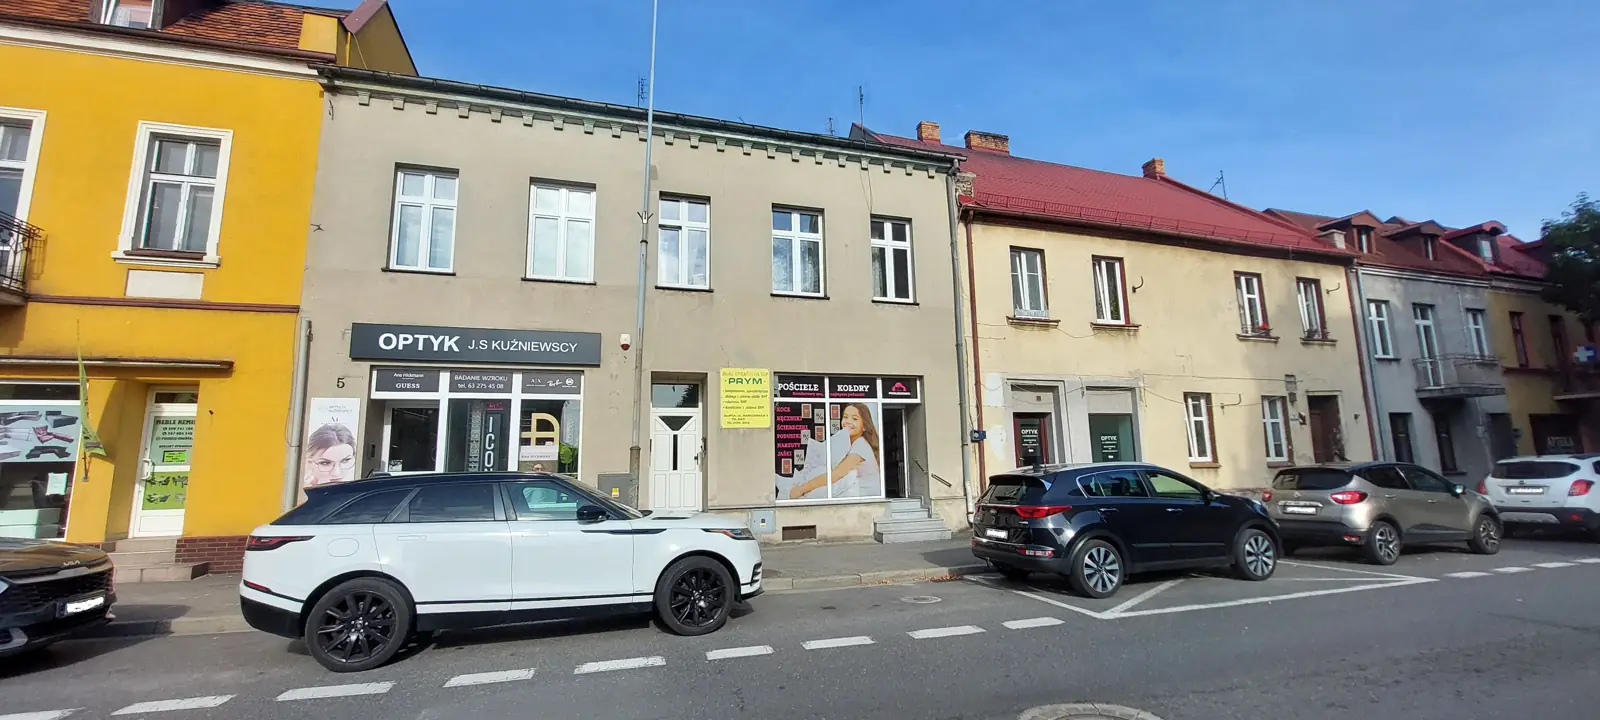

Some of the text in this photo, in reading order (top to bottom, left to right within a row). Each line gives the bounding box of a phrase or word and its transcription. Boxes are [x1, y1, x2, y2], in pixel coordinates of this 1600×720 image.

[378, 332, 578, 353] OPTYK J.S KUŹNIEWSCY
[336, 377, 346, 389] 5
[728, 377, 763, 385] PRYM
[777, 382, 820, 391] POŚCIELE
